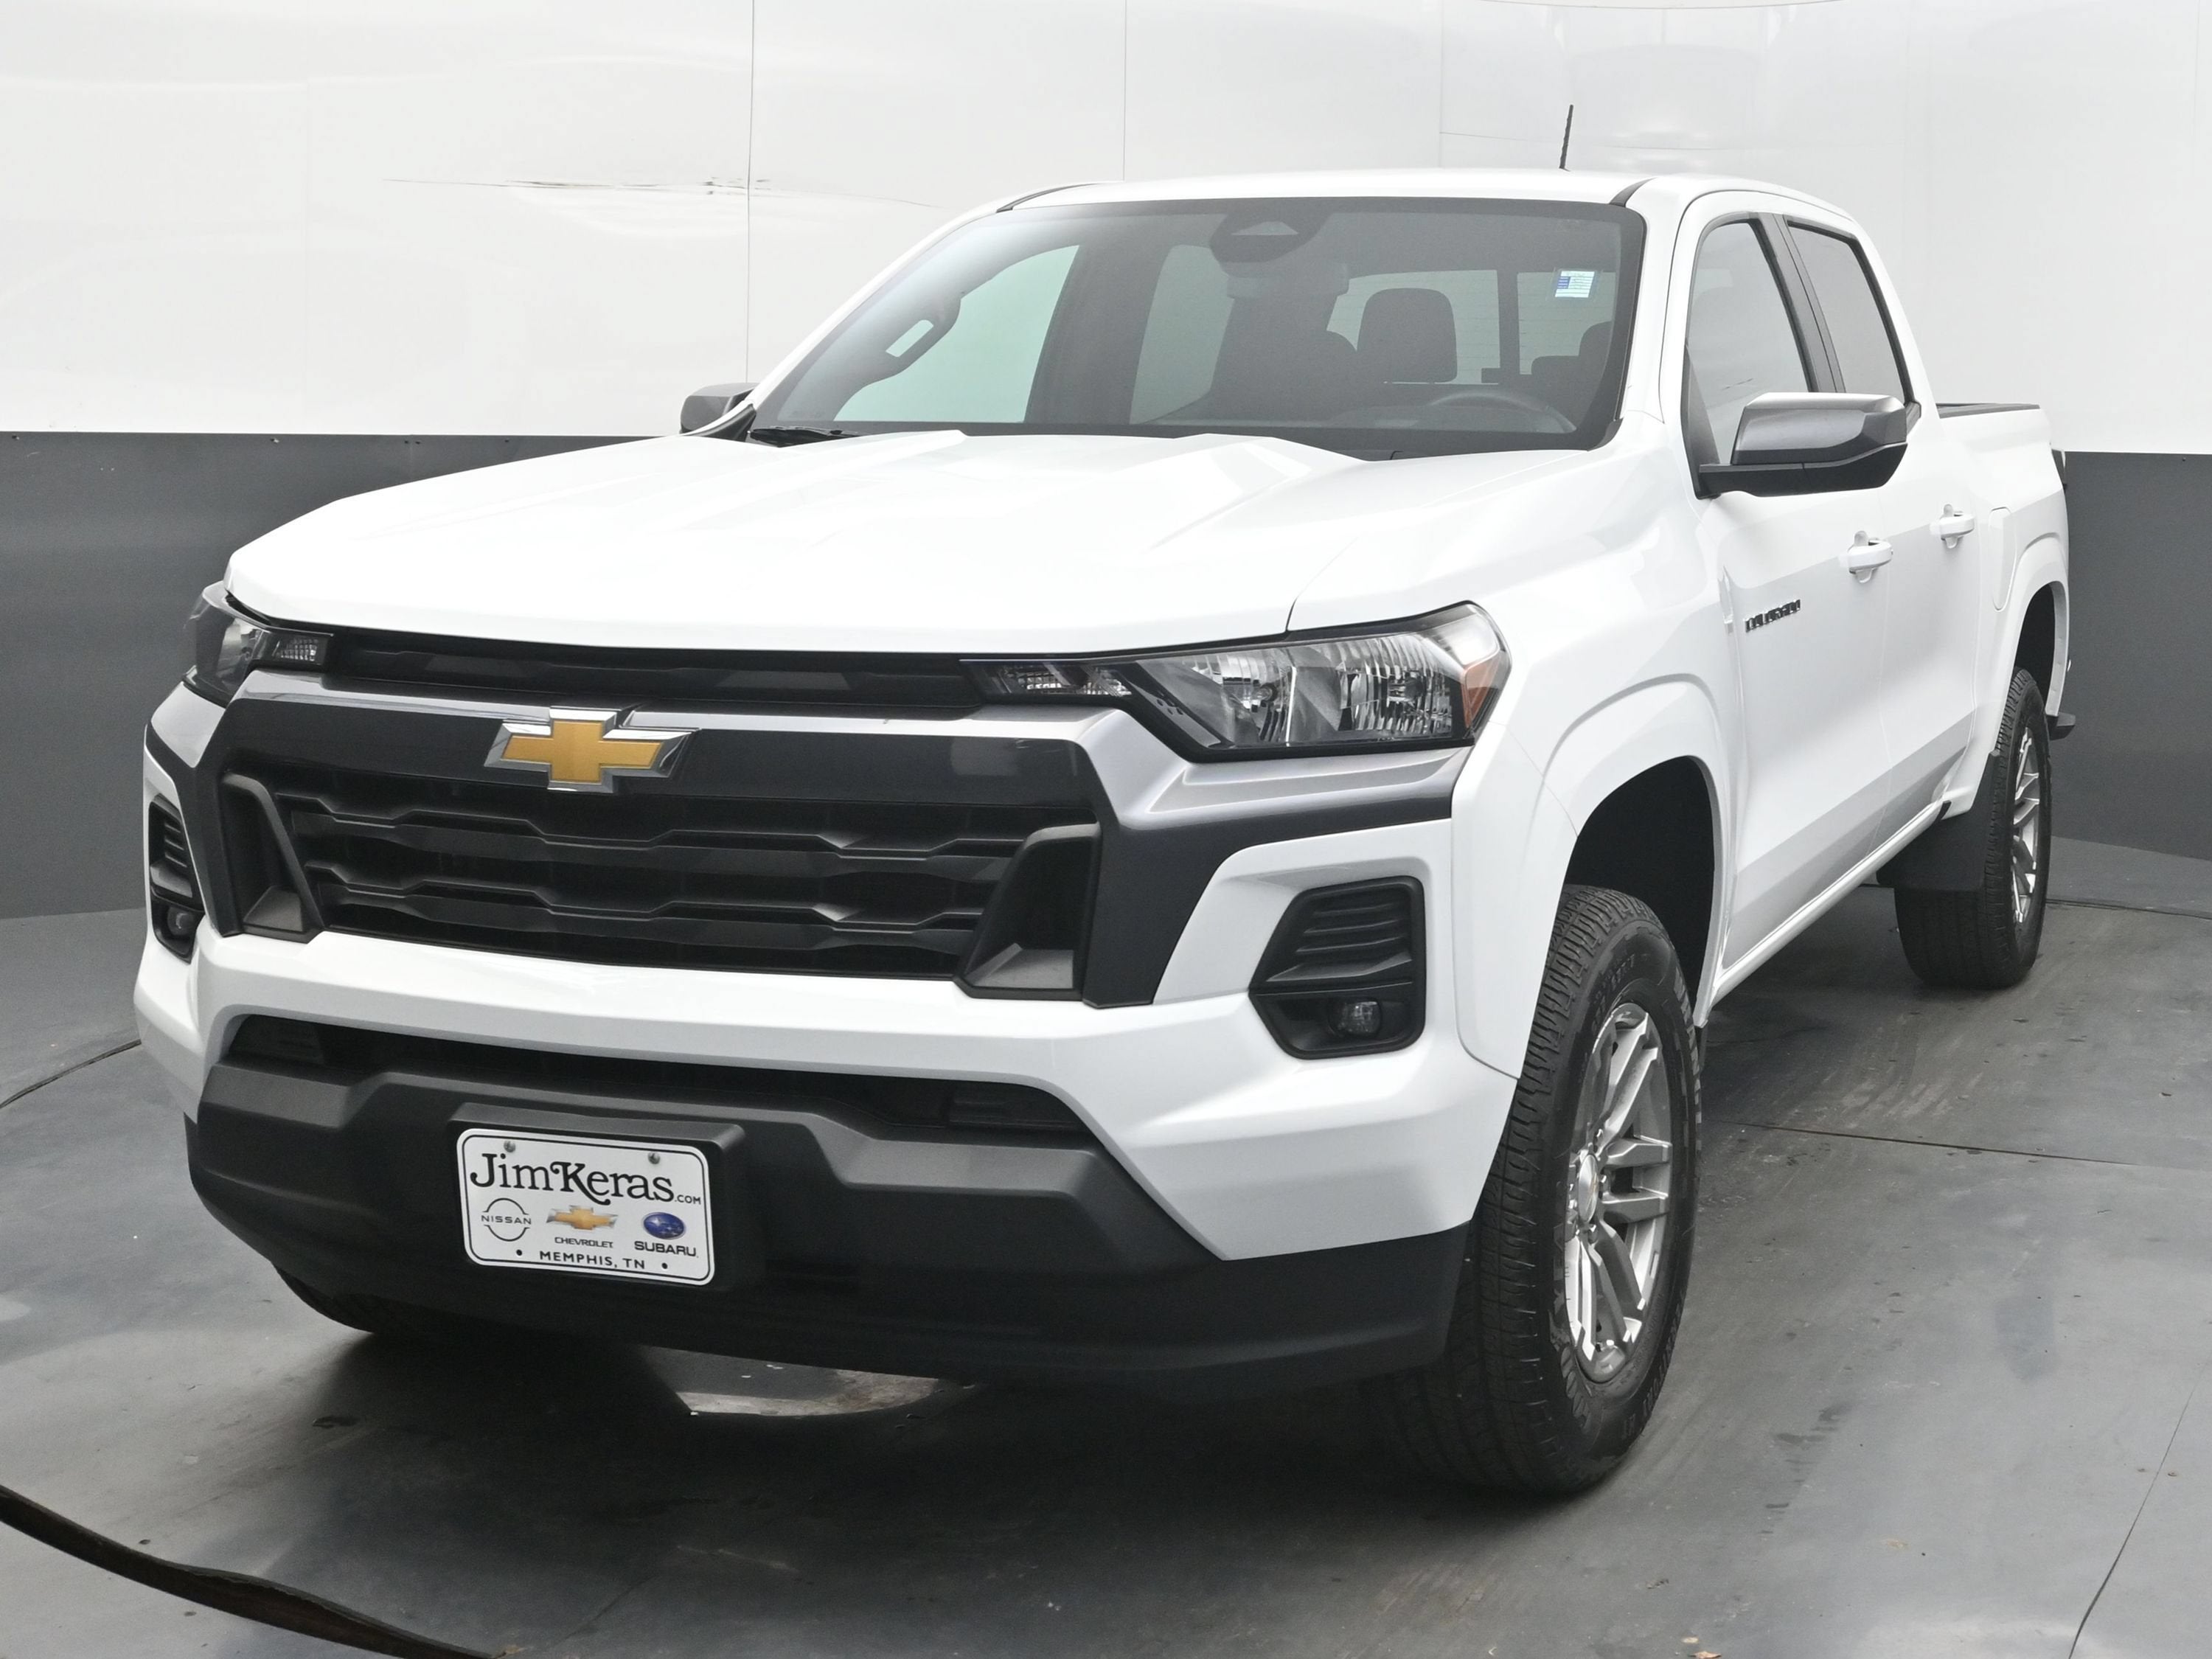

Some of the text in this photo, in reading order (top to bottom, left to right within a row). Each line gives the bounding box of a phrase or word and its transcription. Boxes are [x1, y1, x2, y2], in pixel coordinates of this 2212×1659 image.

[481, 1215, 531, 1225] NISSAN
[554, 1237, 613, 1248] CHEVROLET
[634, 1240, 697, 1257] SUBARU
[539, 1251, 645, 1269] MEMPHIS, TN
